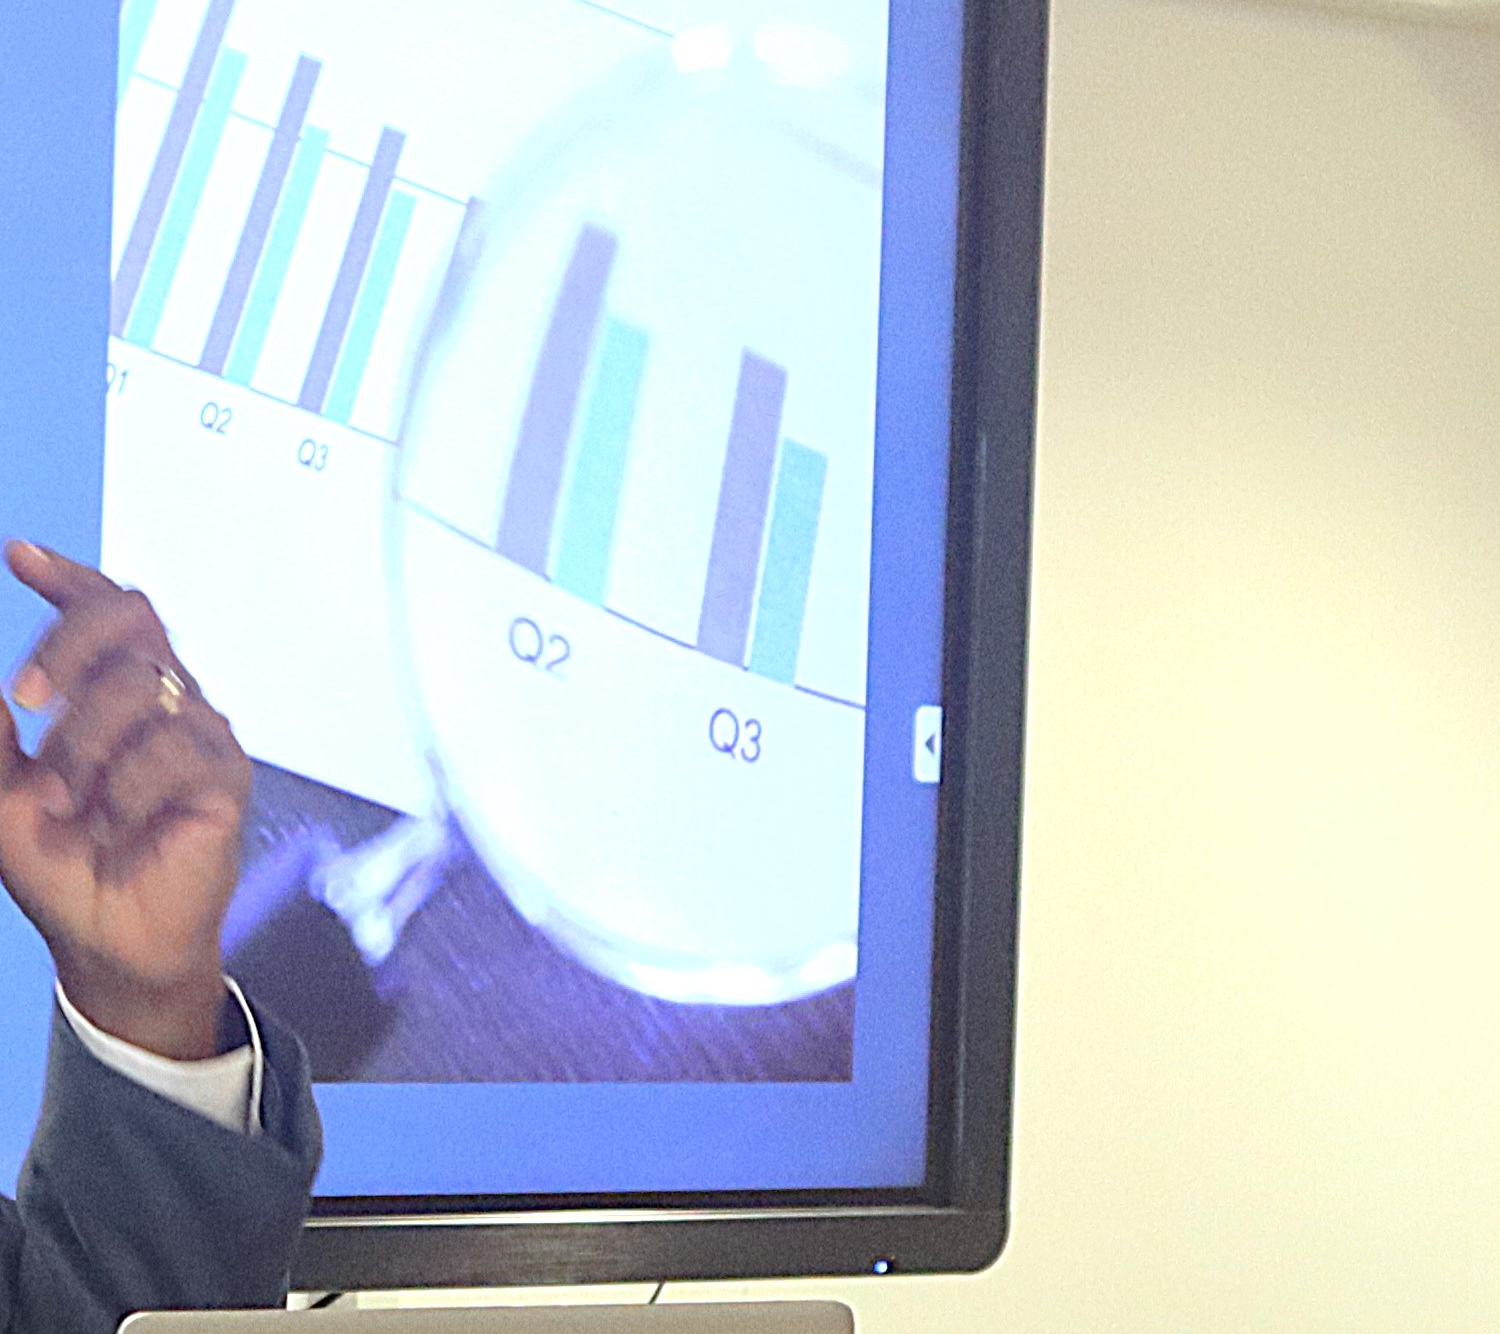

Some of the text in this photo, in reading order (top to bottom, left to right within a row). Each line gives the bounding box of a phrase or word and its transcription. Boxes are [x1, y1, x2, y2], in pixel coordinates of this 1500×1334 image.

[200, 401, 233, 435] Q2
[297, 438, 329, 472] Q3
[508, 616, 571, 681] Q2
[709, 707, 762, 763] Q3
